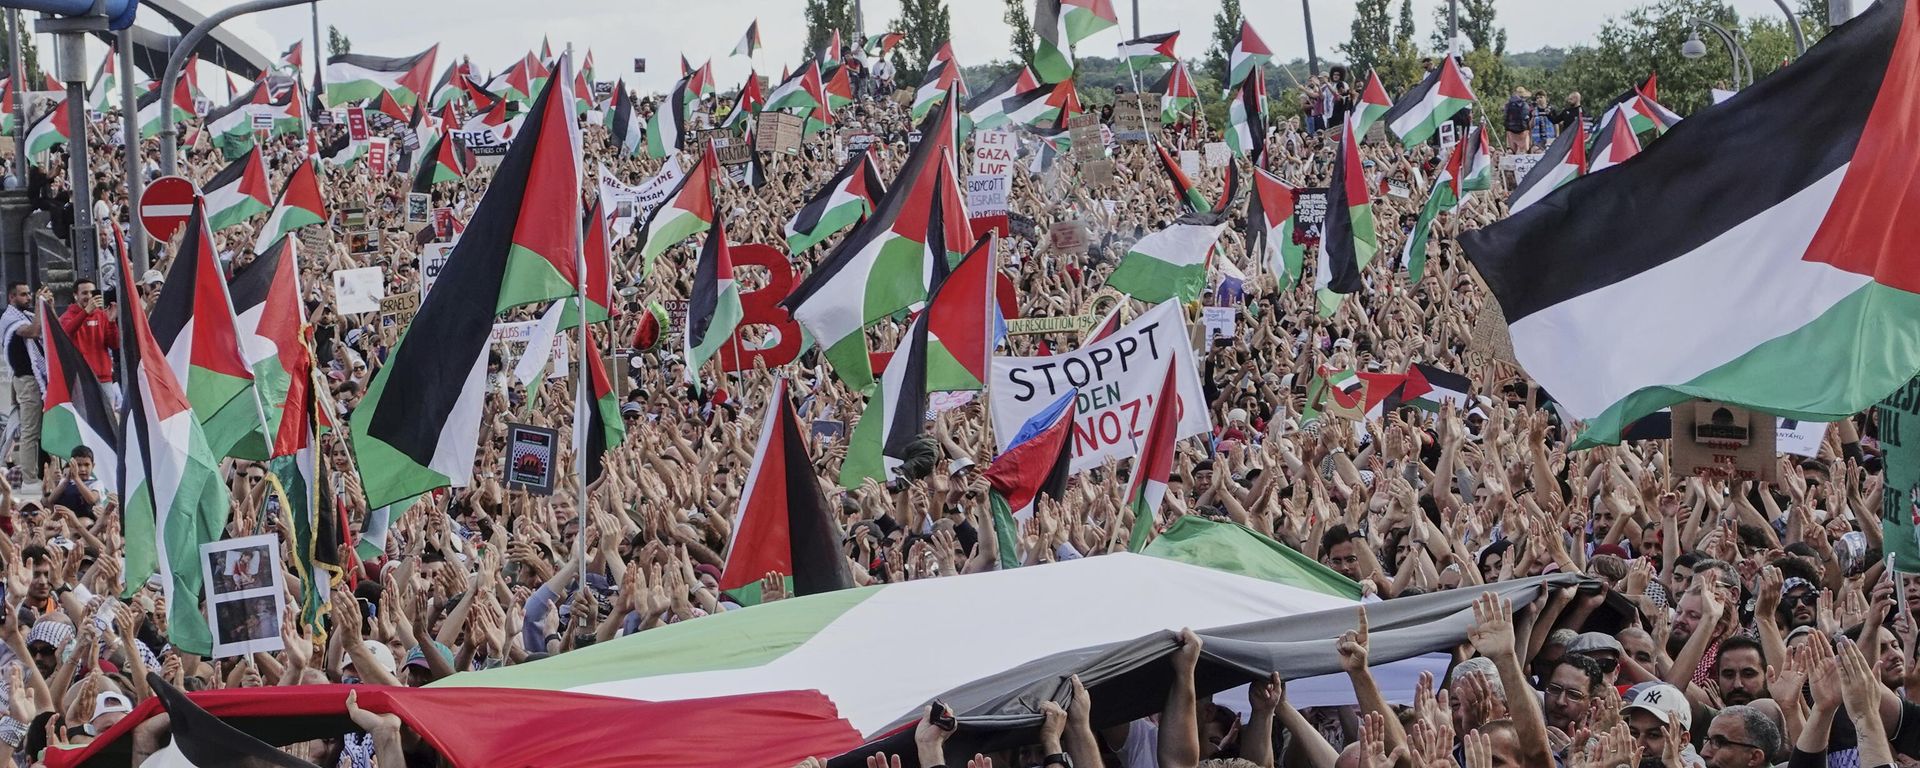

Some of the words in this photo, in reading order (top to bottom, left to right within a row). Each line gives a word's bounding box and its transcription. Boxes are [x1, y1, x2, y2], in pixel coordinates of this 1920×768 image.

[453, 129, 495, 146] FREE
[983, 132, 1007, 144] LET
[977, 148, 1011, 160] GAZA
[980, 163, 1007, 174] LIVE
[969, 178, 1004, 192] BOYCOTT
[381, 295, 415, 312] ISRAEL'S
[1007, 316, 1074, 333] UN-RESOLUTION
[492, 326, 519, 340] CHLUSS
[1009, 322, 1160, 402] STOPPT
[1076, 381, 1121, 415] DEN
